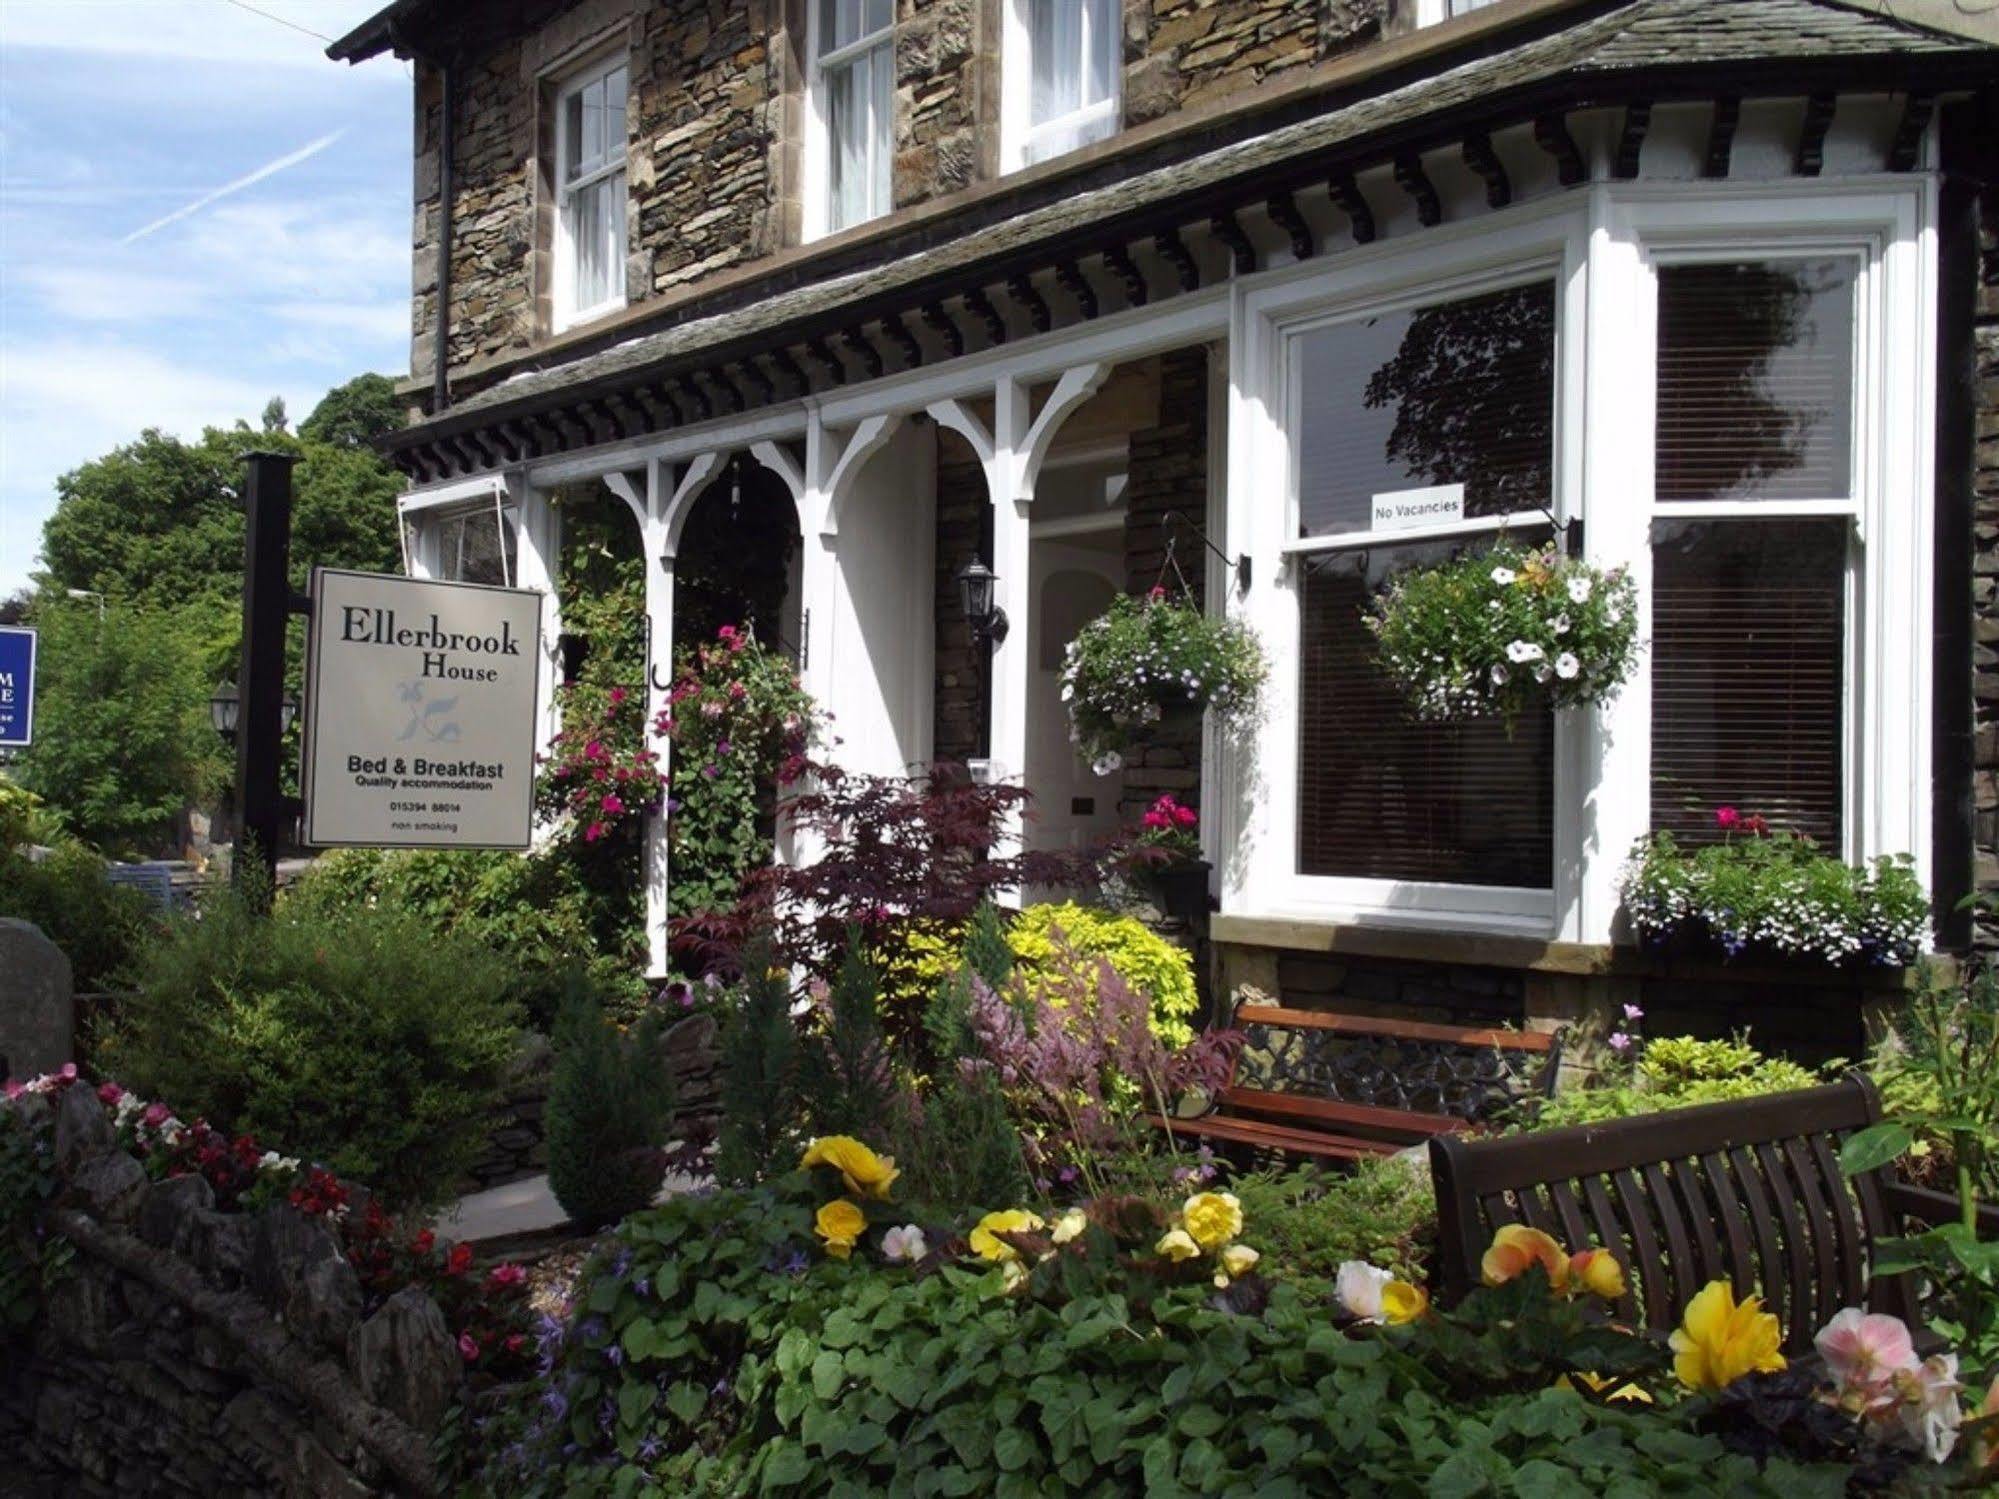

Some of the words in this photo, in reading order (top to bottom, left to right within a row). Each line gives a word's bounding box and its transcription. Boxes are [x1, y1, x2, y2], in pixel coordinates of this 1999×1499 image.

[1375, 507, 1393, 519] No
[1396, 500, 1459, 516] Vacancies
[341, 606, 520, 656] Ellerbrook
[422, 652, 498, 683] House
[347, 754, 387, 774] Bed
[393, 758, 407, 775] &
[413, 758, 504, 779] Breakfast
[355, 774, 397, 789] Quality
[401, 779, 493, 791] accommodation
[390, 801, 427, 812] 015394
[391, 821, 411, 831] non
[414, 822, 458, 834] smoking
